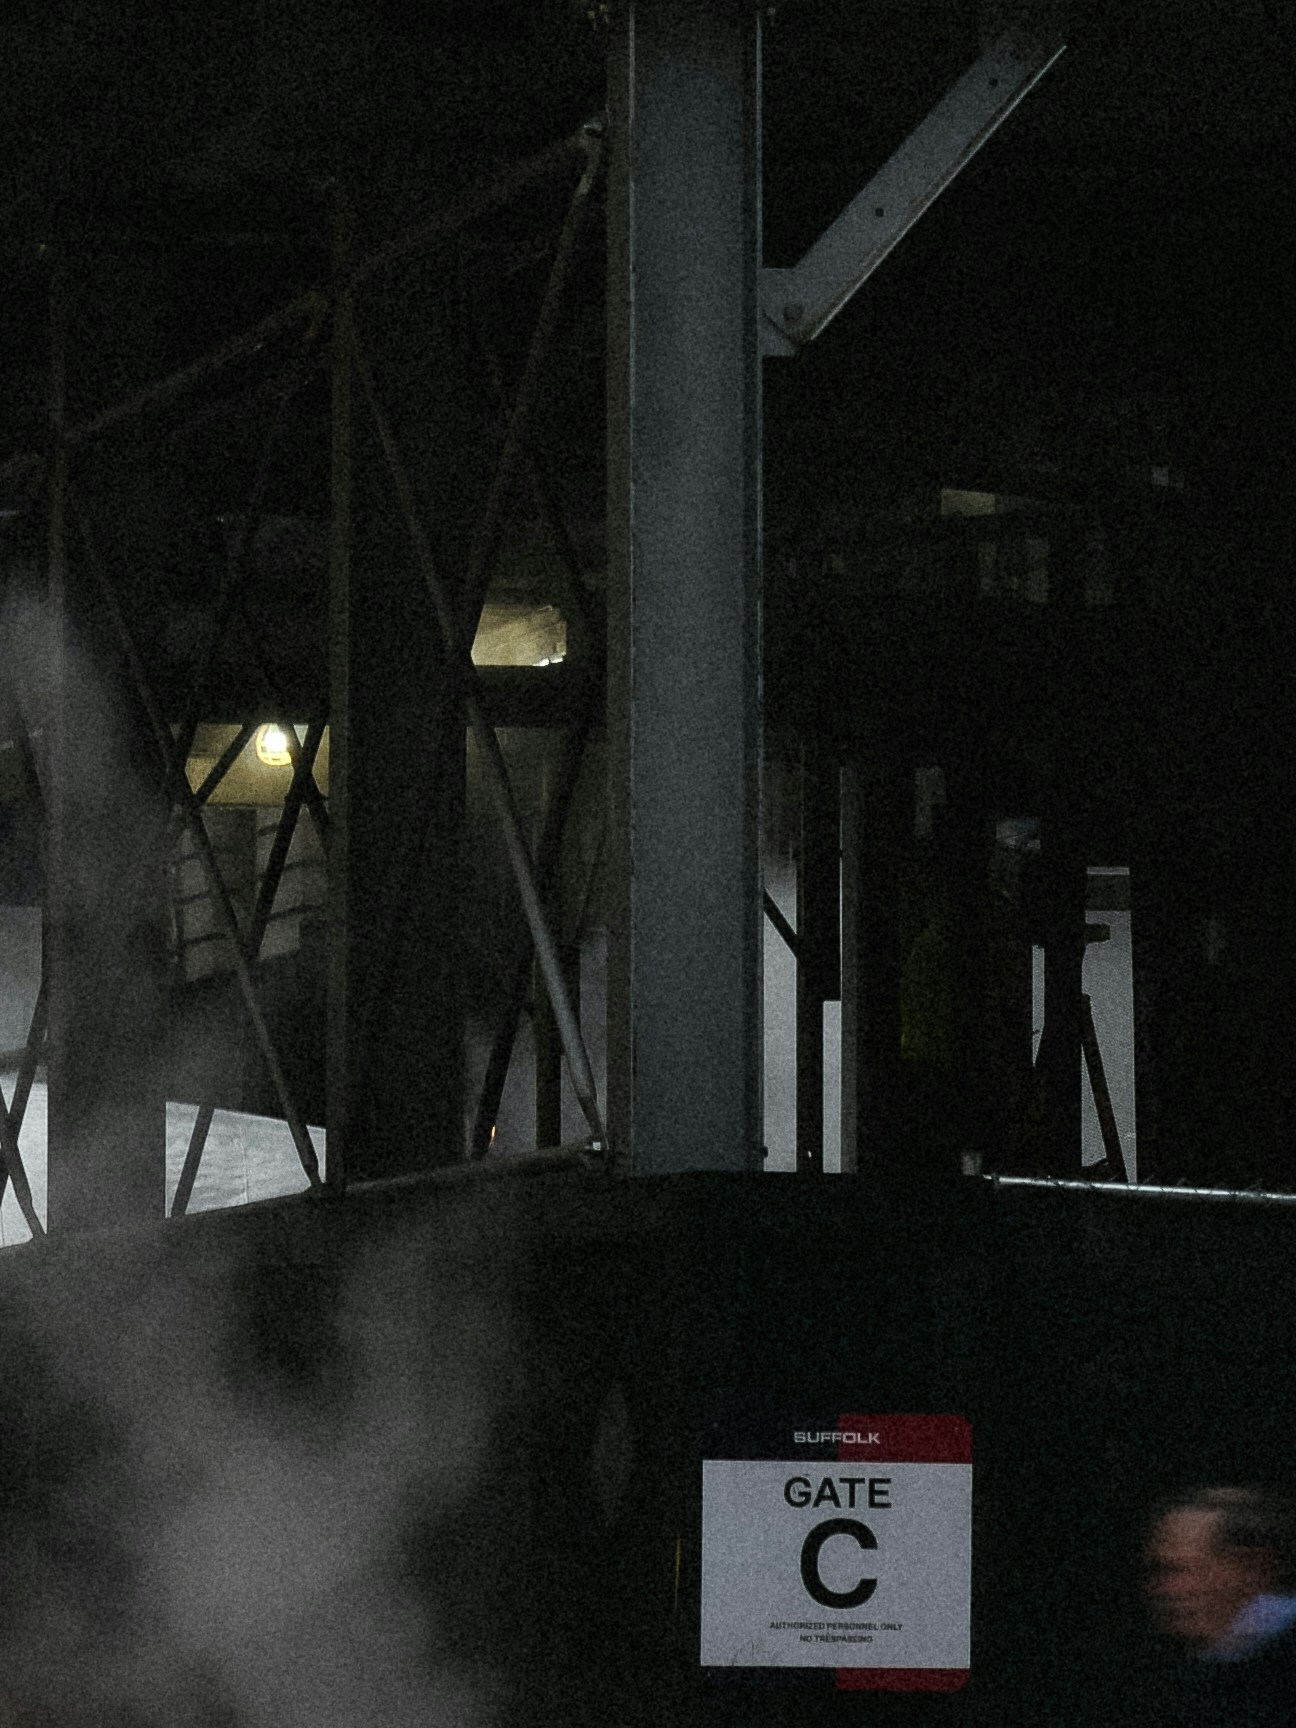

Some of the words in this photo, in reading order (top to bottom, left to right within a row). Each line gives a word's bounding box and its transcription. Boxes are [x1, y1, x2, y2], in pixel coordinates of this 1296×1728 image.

[793, 1431, 881, 1445] SUFFOLK
[784, 1476, 893, 1509] GATE
[800, 1517, 879, 1610] C
[769, 1622, 825, 1631] AUTHORIZED
[826, 1622, 879, 1632] PERSONNEL
[880, 1623, 903, 1632] ONLY
[800, 1635, 813, 1643] NO
[815, 1635, 874, 1644] TRESPASSING
